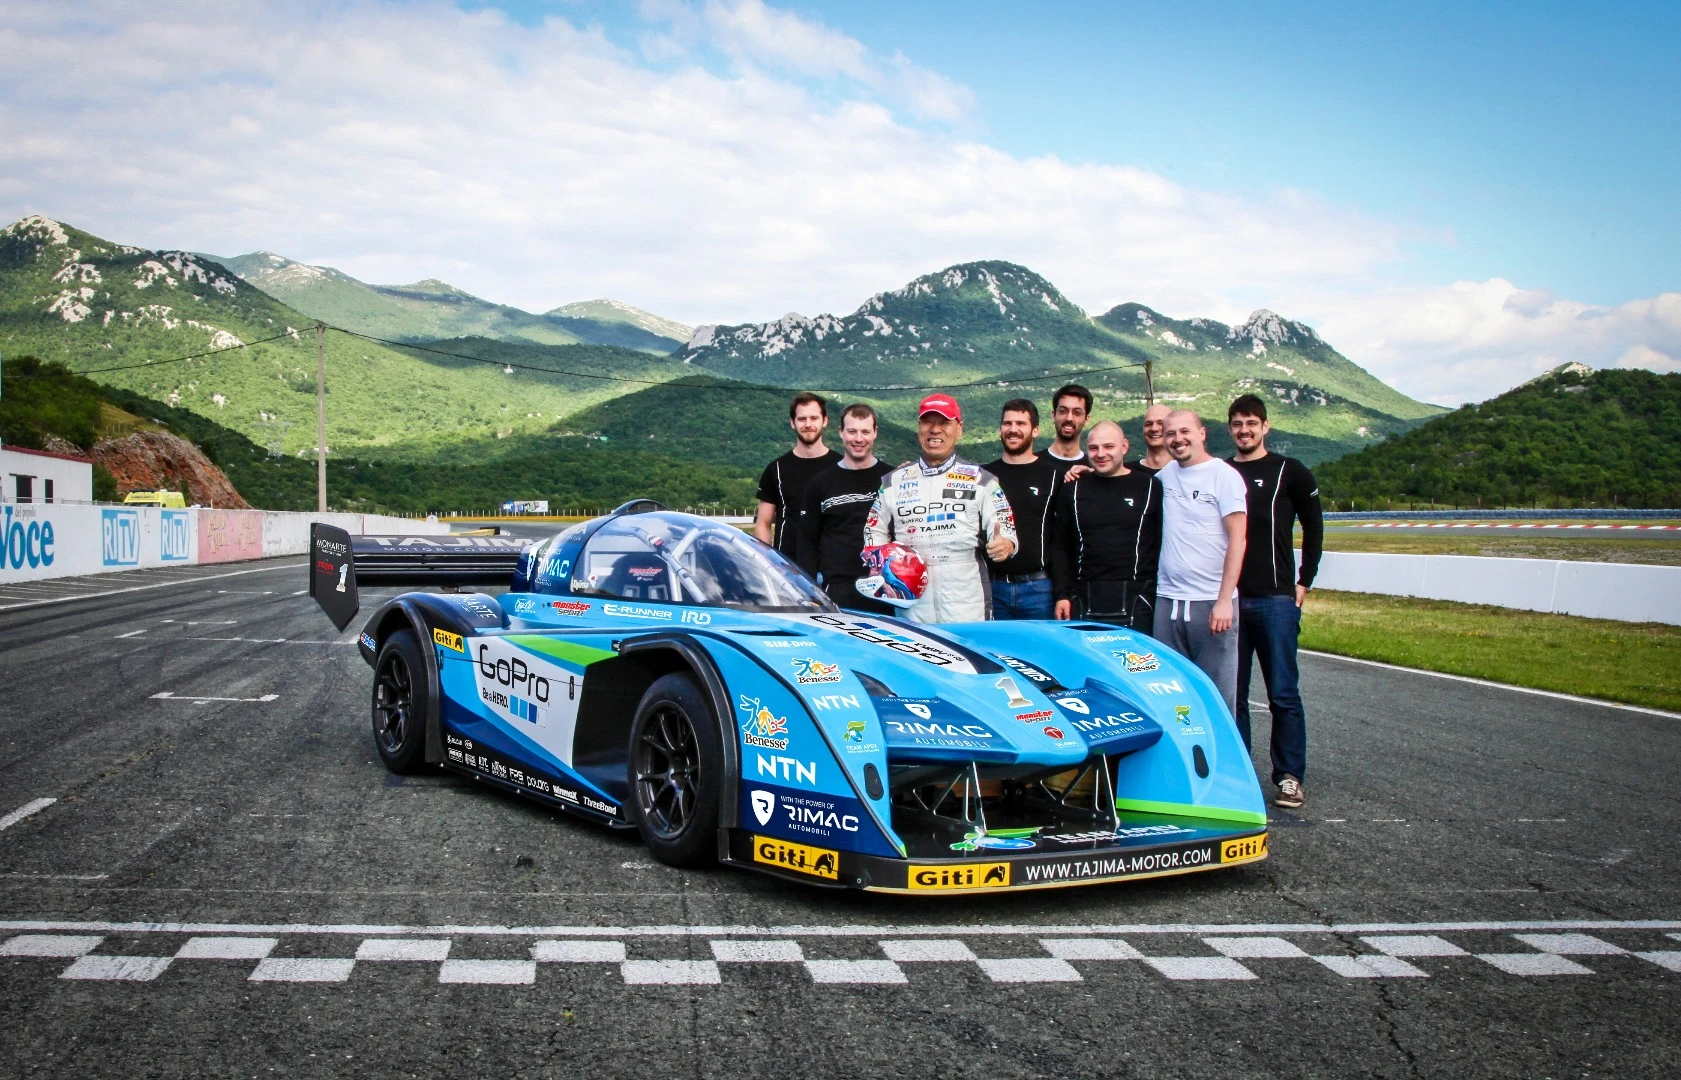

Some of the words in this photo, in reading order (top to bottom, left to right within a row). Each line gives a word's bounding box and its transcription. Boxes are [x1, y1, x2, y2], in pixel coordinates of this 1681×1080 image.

[897, 502, 967, 517] GoPro
[920, 524, 957, 533] TAJIMA
[363, 537, 536, 547] TAJIM
[336, 563, 349, 593] 1
[435, 632, 452, 646] Giti
[480, 643, 550, 703] GoPro
[798, 675, 840, 684] Benesse
[995, 677, 1034, 709] 1
[812, 694, 860, 711] NTN
[886, 721, 993, 738] RIMAC
[1072, 712, 1144, 733] IMAC
[745, 732, 786, 750] Benesse
[914, 737, 992, 749] AUTOMOBILI
[757, 752, 817, 786] NTN
[780, 795, 794, 803] WITH
[794, 797, 805, 805] THE
[805, 799, 826, 809] POWER
[782, 804, 859, 832] RIMAC
[788, 823, 830, 837] AUTOMOBILI
[759, 843, 806, 869] Giti
[1225, 839, 1257, 860] Giti
[1026, 848, 1212, 881] WWW.TAJIMA-MOTOR.COM
[915, 869, 974, 887] Giti
